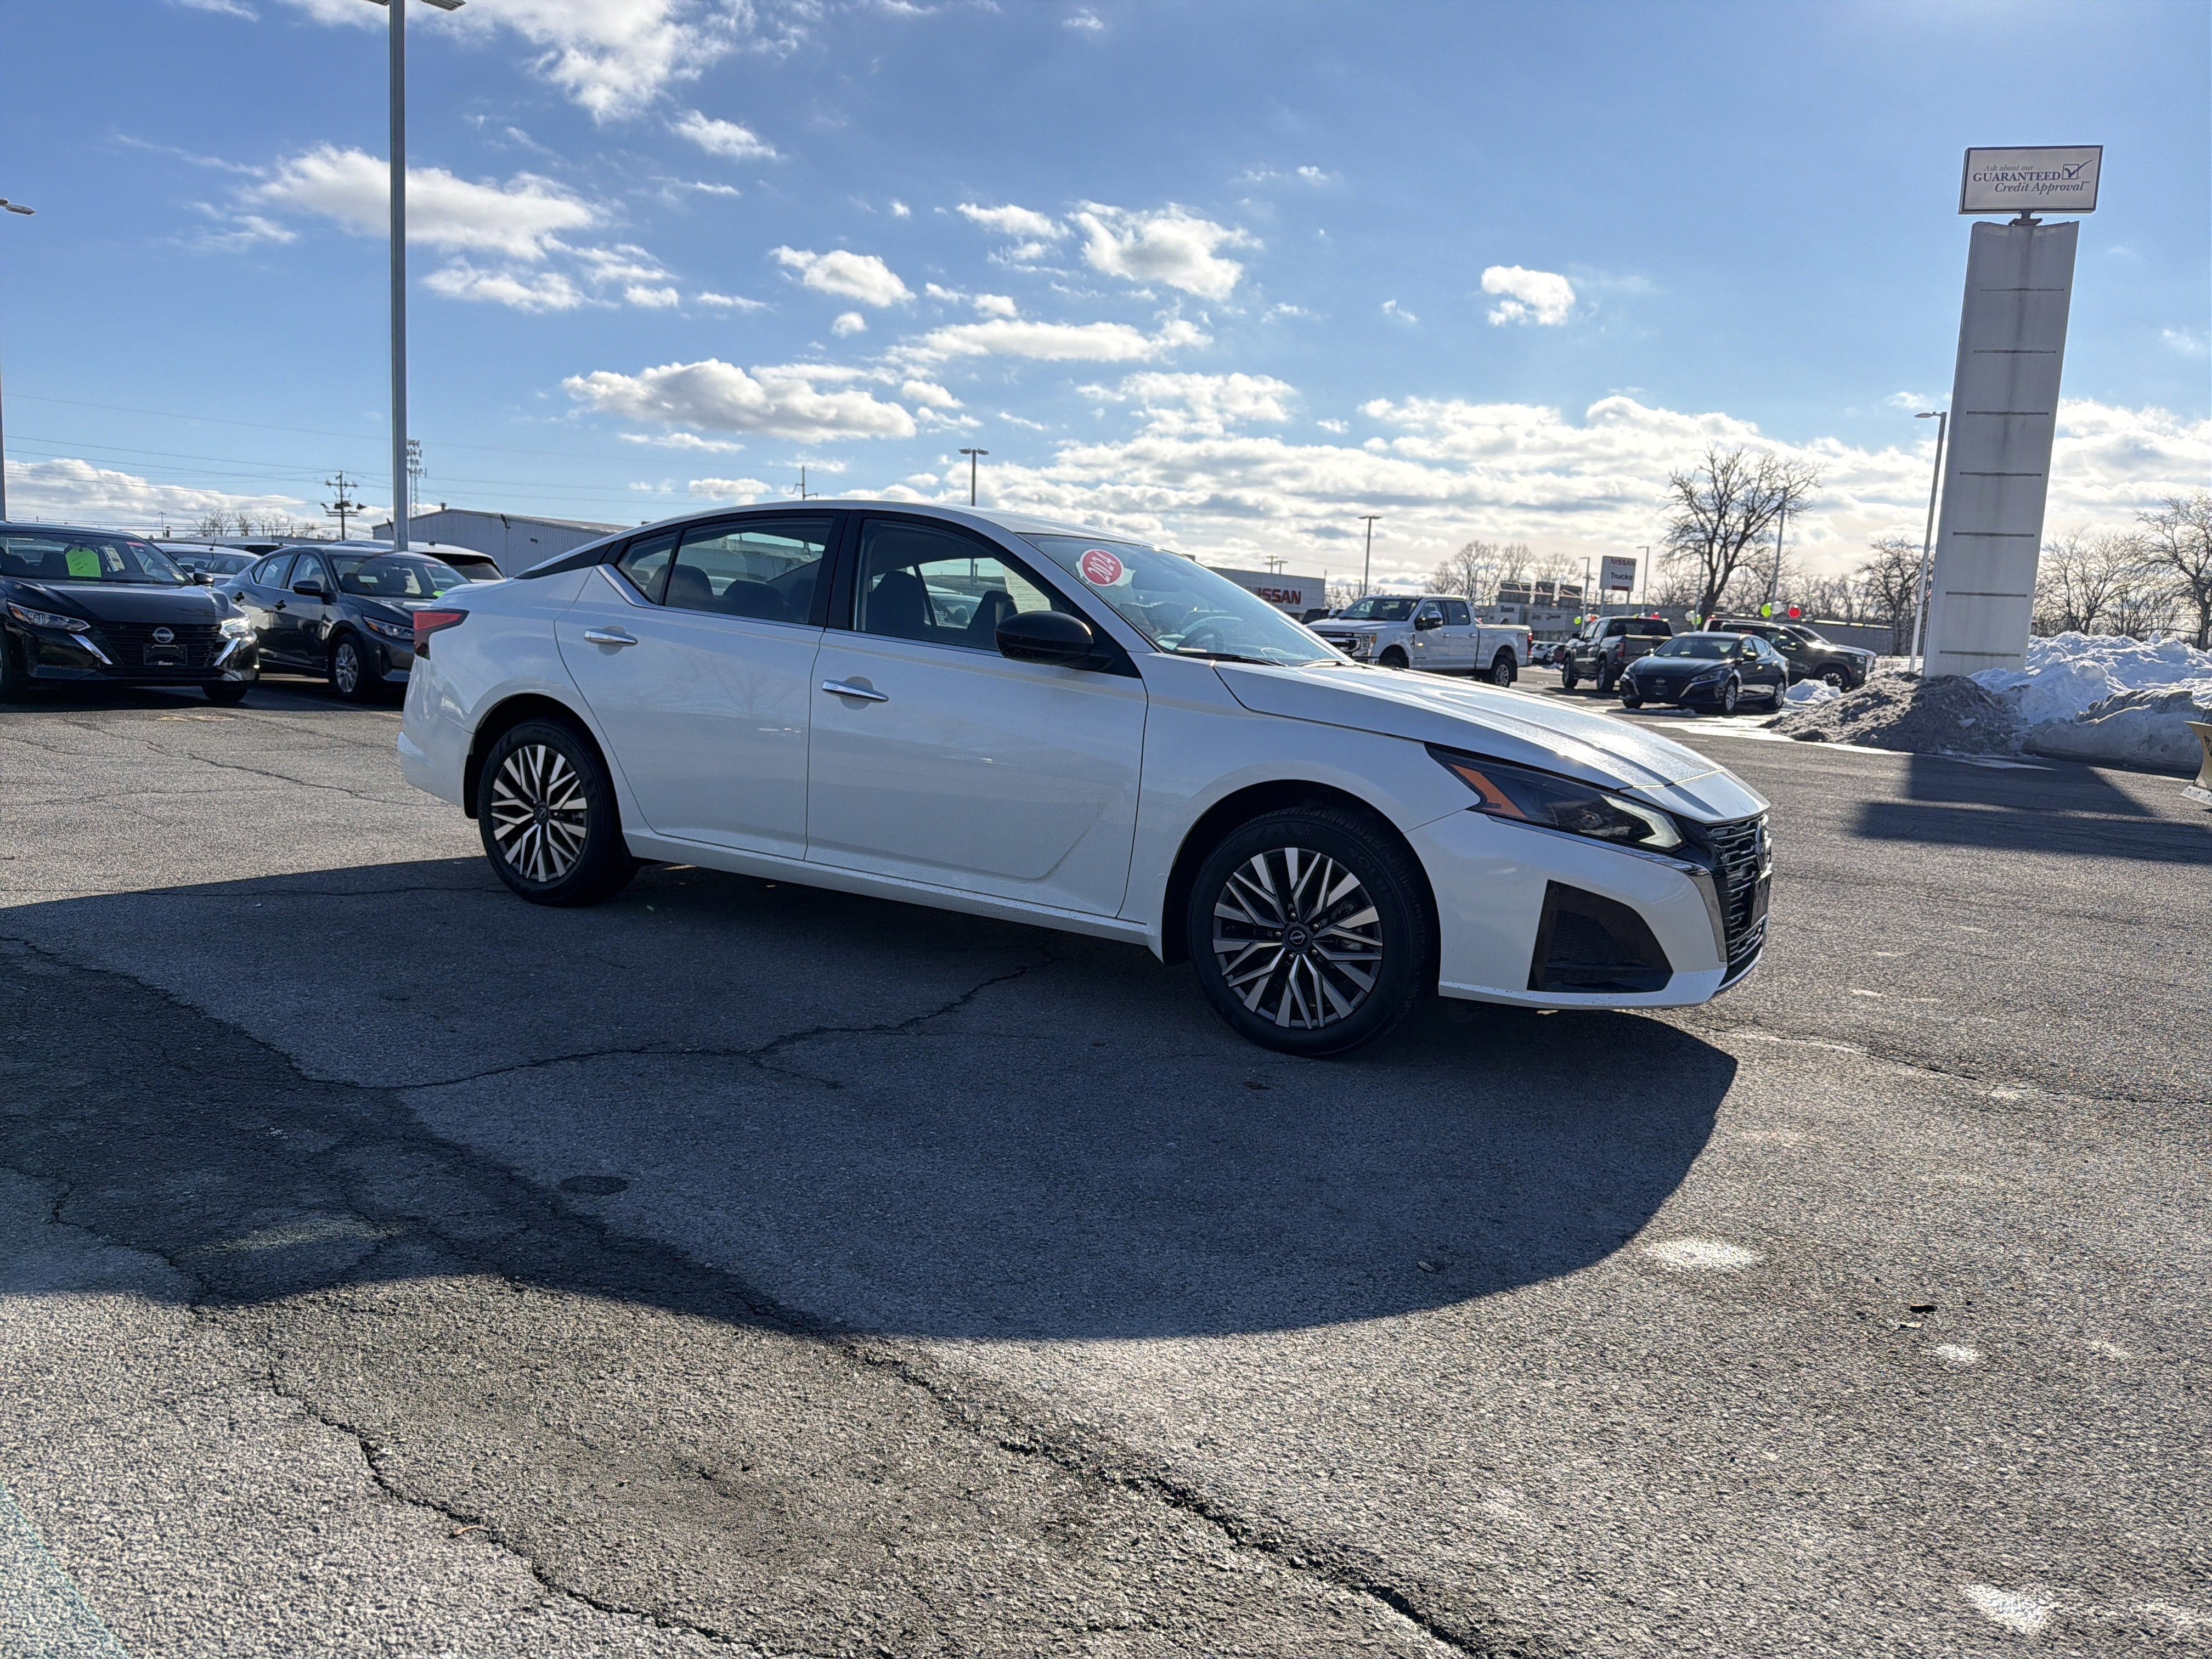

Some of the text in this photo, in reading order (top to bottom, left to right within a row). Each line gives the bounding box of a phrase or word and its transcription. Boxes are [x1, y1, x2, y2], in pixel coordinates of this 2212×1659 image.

[1973, 171, 2061, 182] GUARANTEED
[1994, 182, 2029, 192] Credit
[1087, 551, 1116, 583] 2024
[1610, 558, 1635, 567] NISSAN
[1610, 572, 1633, 580] Trucks
